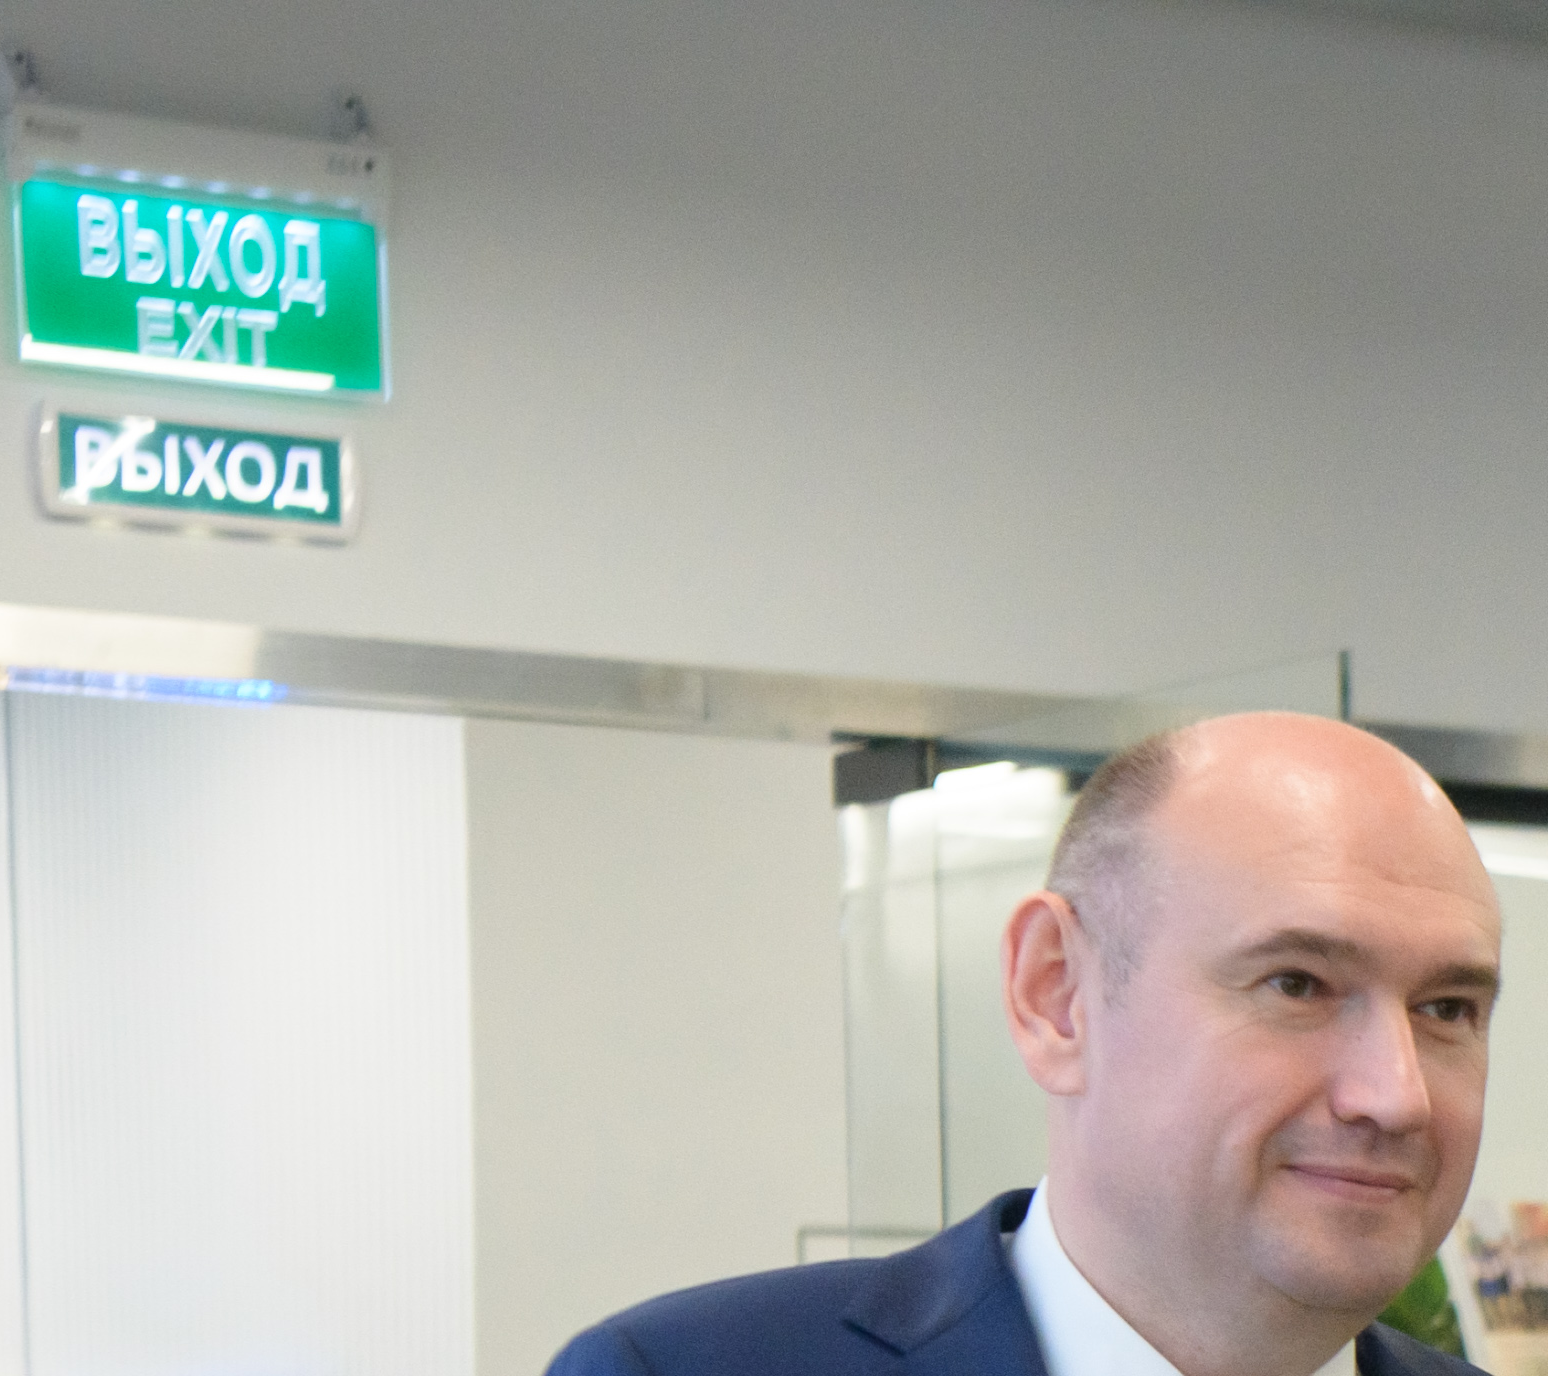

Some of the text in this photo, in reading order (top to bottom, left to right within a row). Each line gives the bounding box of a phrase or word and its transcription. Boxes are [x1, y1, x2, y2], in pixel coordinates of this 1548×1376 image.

[77, 194, 327, 317] ВЫХОД
[136, 296, 279, 367] EXIT
[73, 425, 330, 513] ВЫХОД
